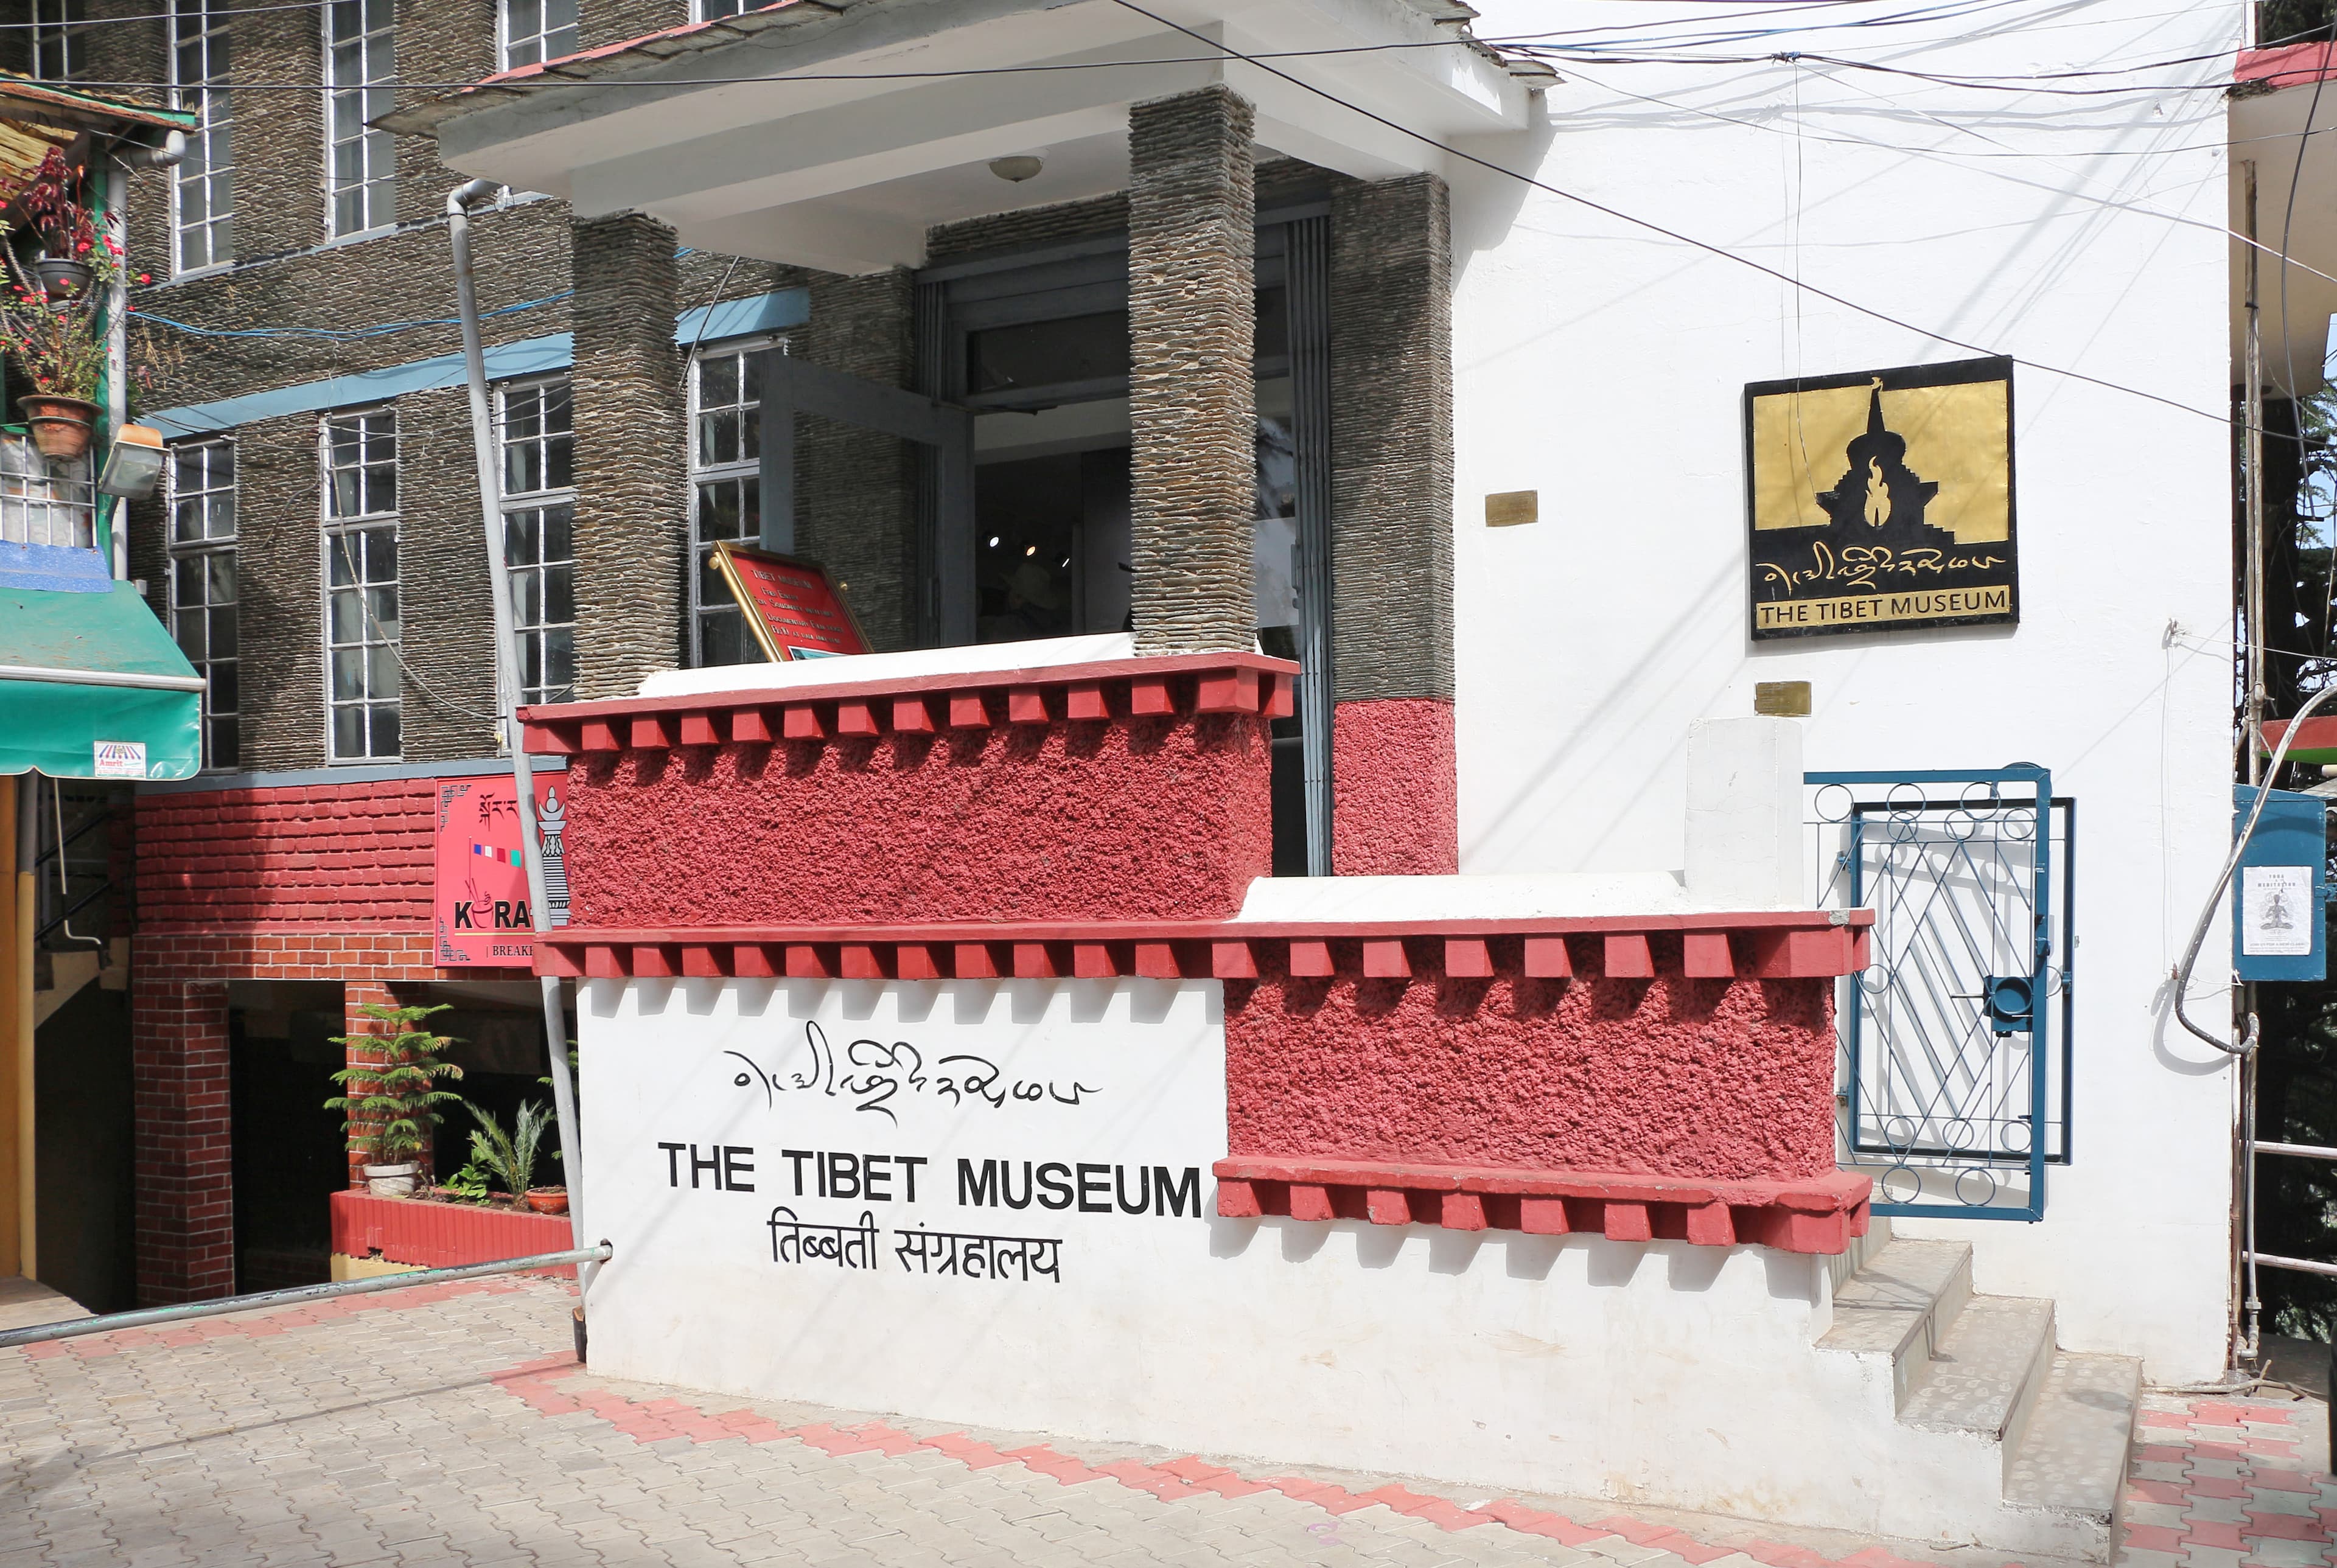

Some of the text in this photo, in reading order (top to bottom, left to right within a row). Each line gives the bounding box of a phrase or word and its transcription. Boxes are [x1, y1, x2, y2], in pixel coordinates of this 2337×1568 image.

[751, 570, 775, 581] TIBET
[1761, 590, 2005, 624] THE TIBET MUSEUM
[658, 1141, 1202, 1218] THE TIBET MUSEUM
[766, 1206, 1063, 1284] तिब्बती संग्रहालय
